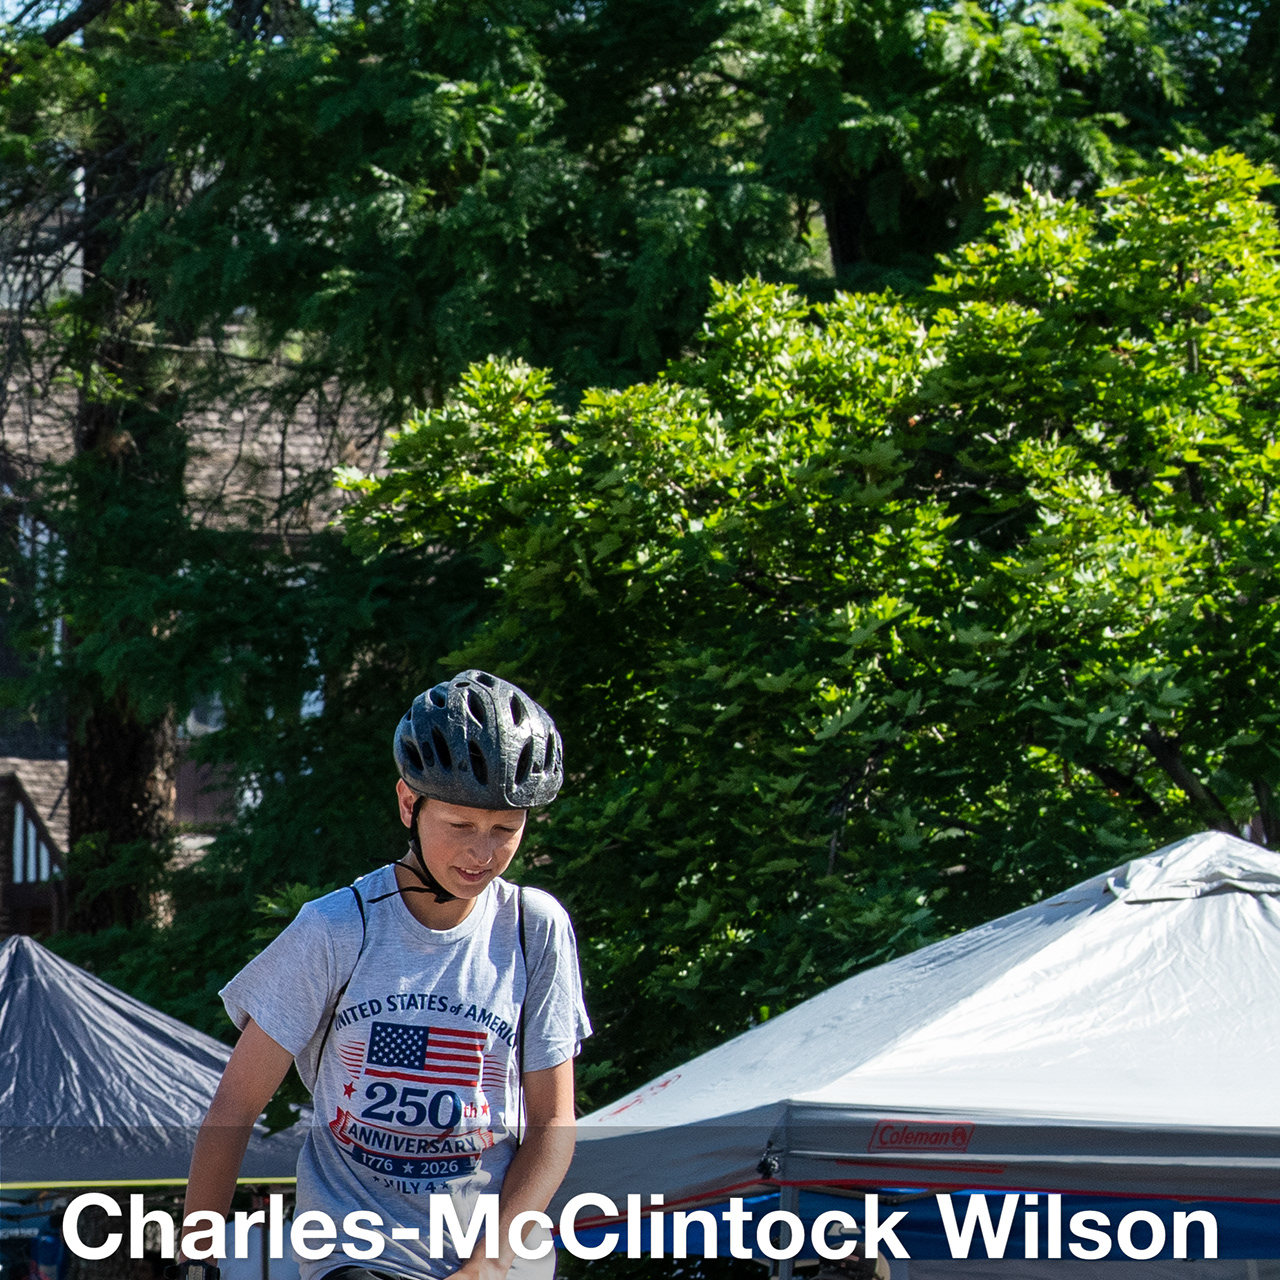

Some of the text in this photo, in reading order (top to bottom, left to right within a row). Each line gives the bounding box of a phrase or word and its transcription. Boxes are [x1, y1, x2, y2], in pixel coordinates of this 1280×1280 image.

[386, 994, 448, 1013] STATES
[450, 1003, 463, 1015] of
[361, 1082, 477, 1129] 250 th
[348, 1123, 478, 1154] ANNIVERSARY
[880, 1125, 949, 1145] Coleman
[362, 1153, 459, 1175] 1776 2026
[425, 1181, 437, 1193] 4
